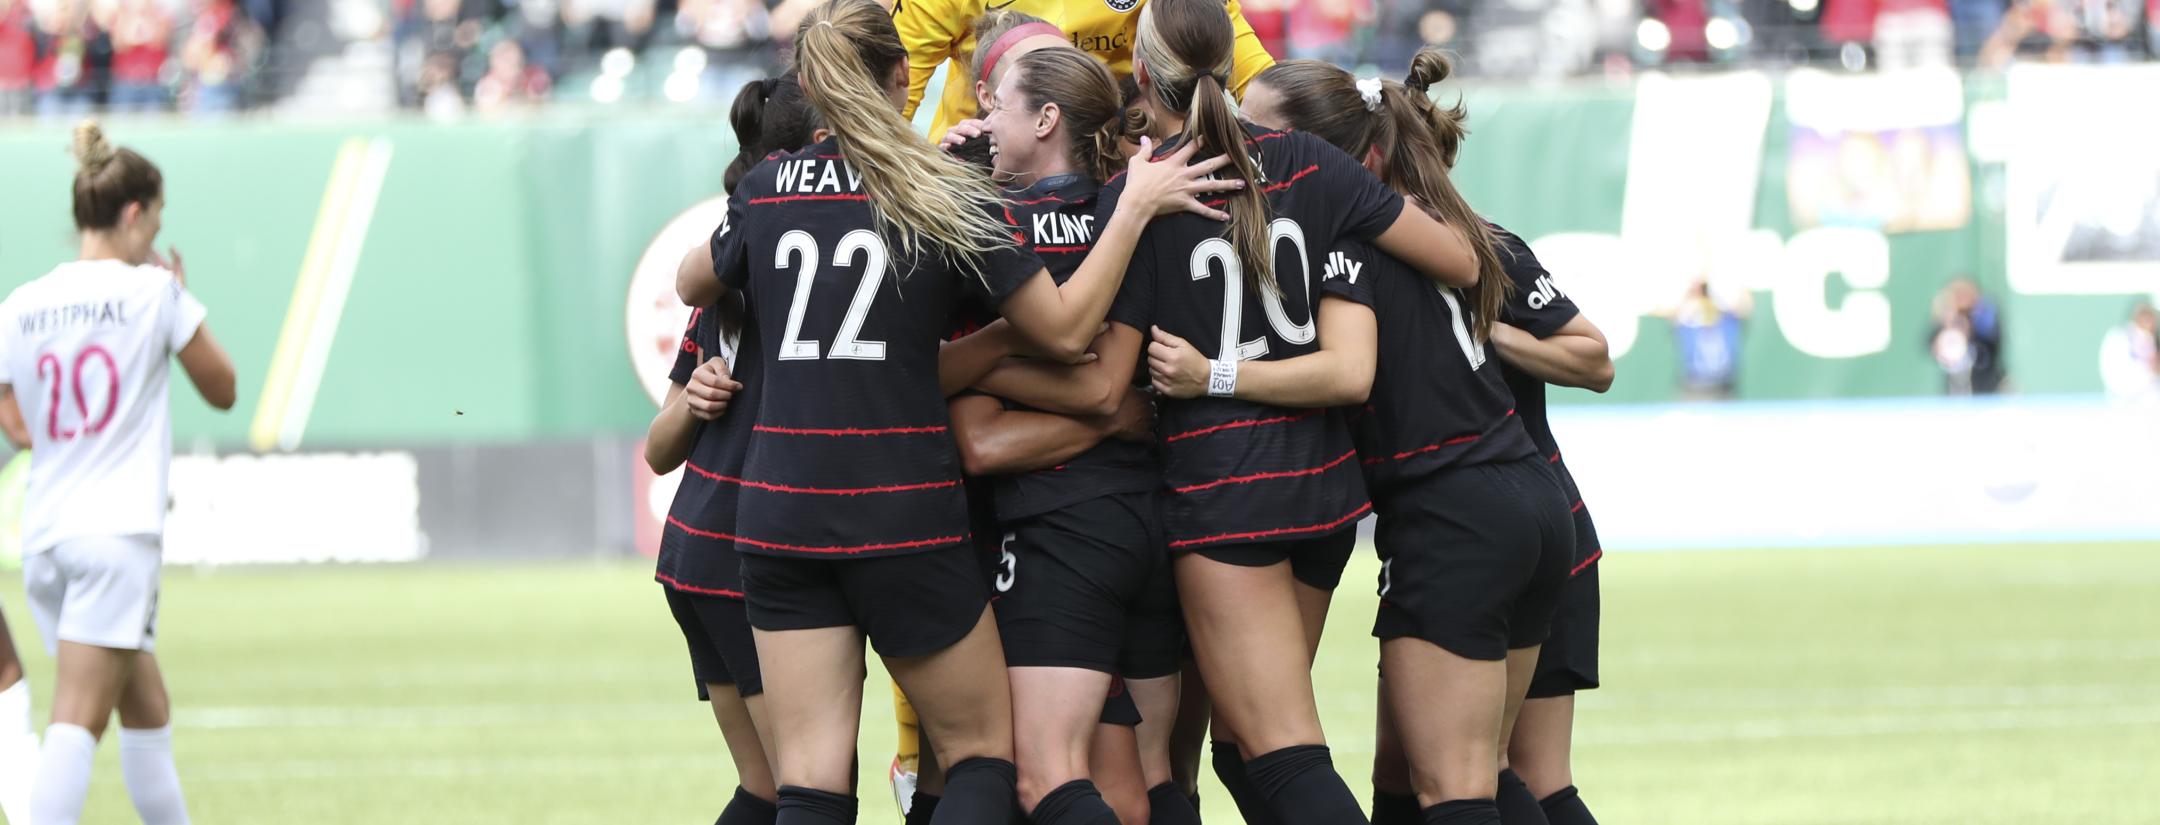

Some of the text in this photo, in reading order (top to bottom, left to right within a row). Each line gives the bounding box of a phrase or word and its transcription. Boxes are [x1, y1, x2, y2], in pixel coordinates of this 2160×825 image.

[18, 301, 128, 336] WESTPHAL
[775, 229, 887, 361] 22
[1189, 217, 1316, 362] 20
[37, 345, 120, 442] 20
